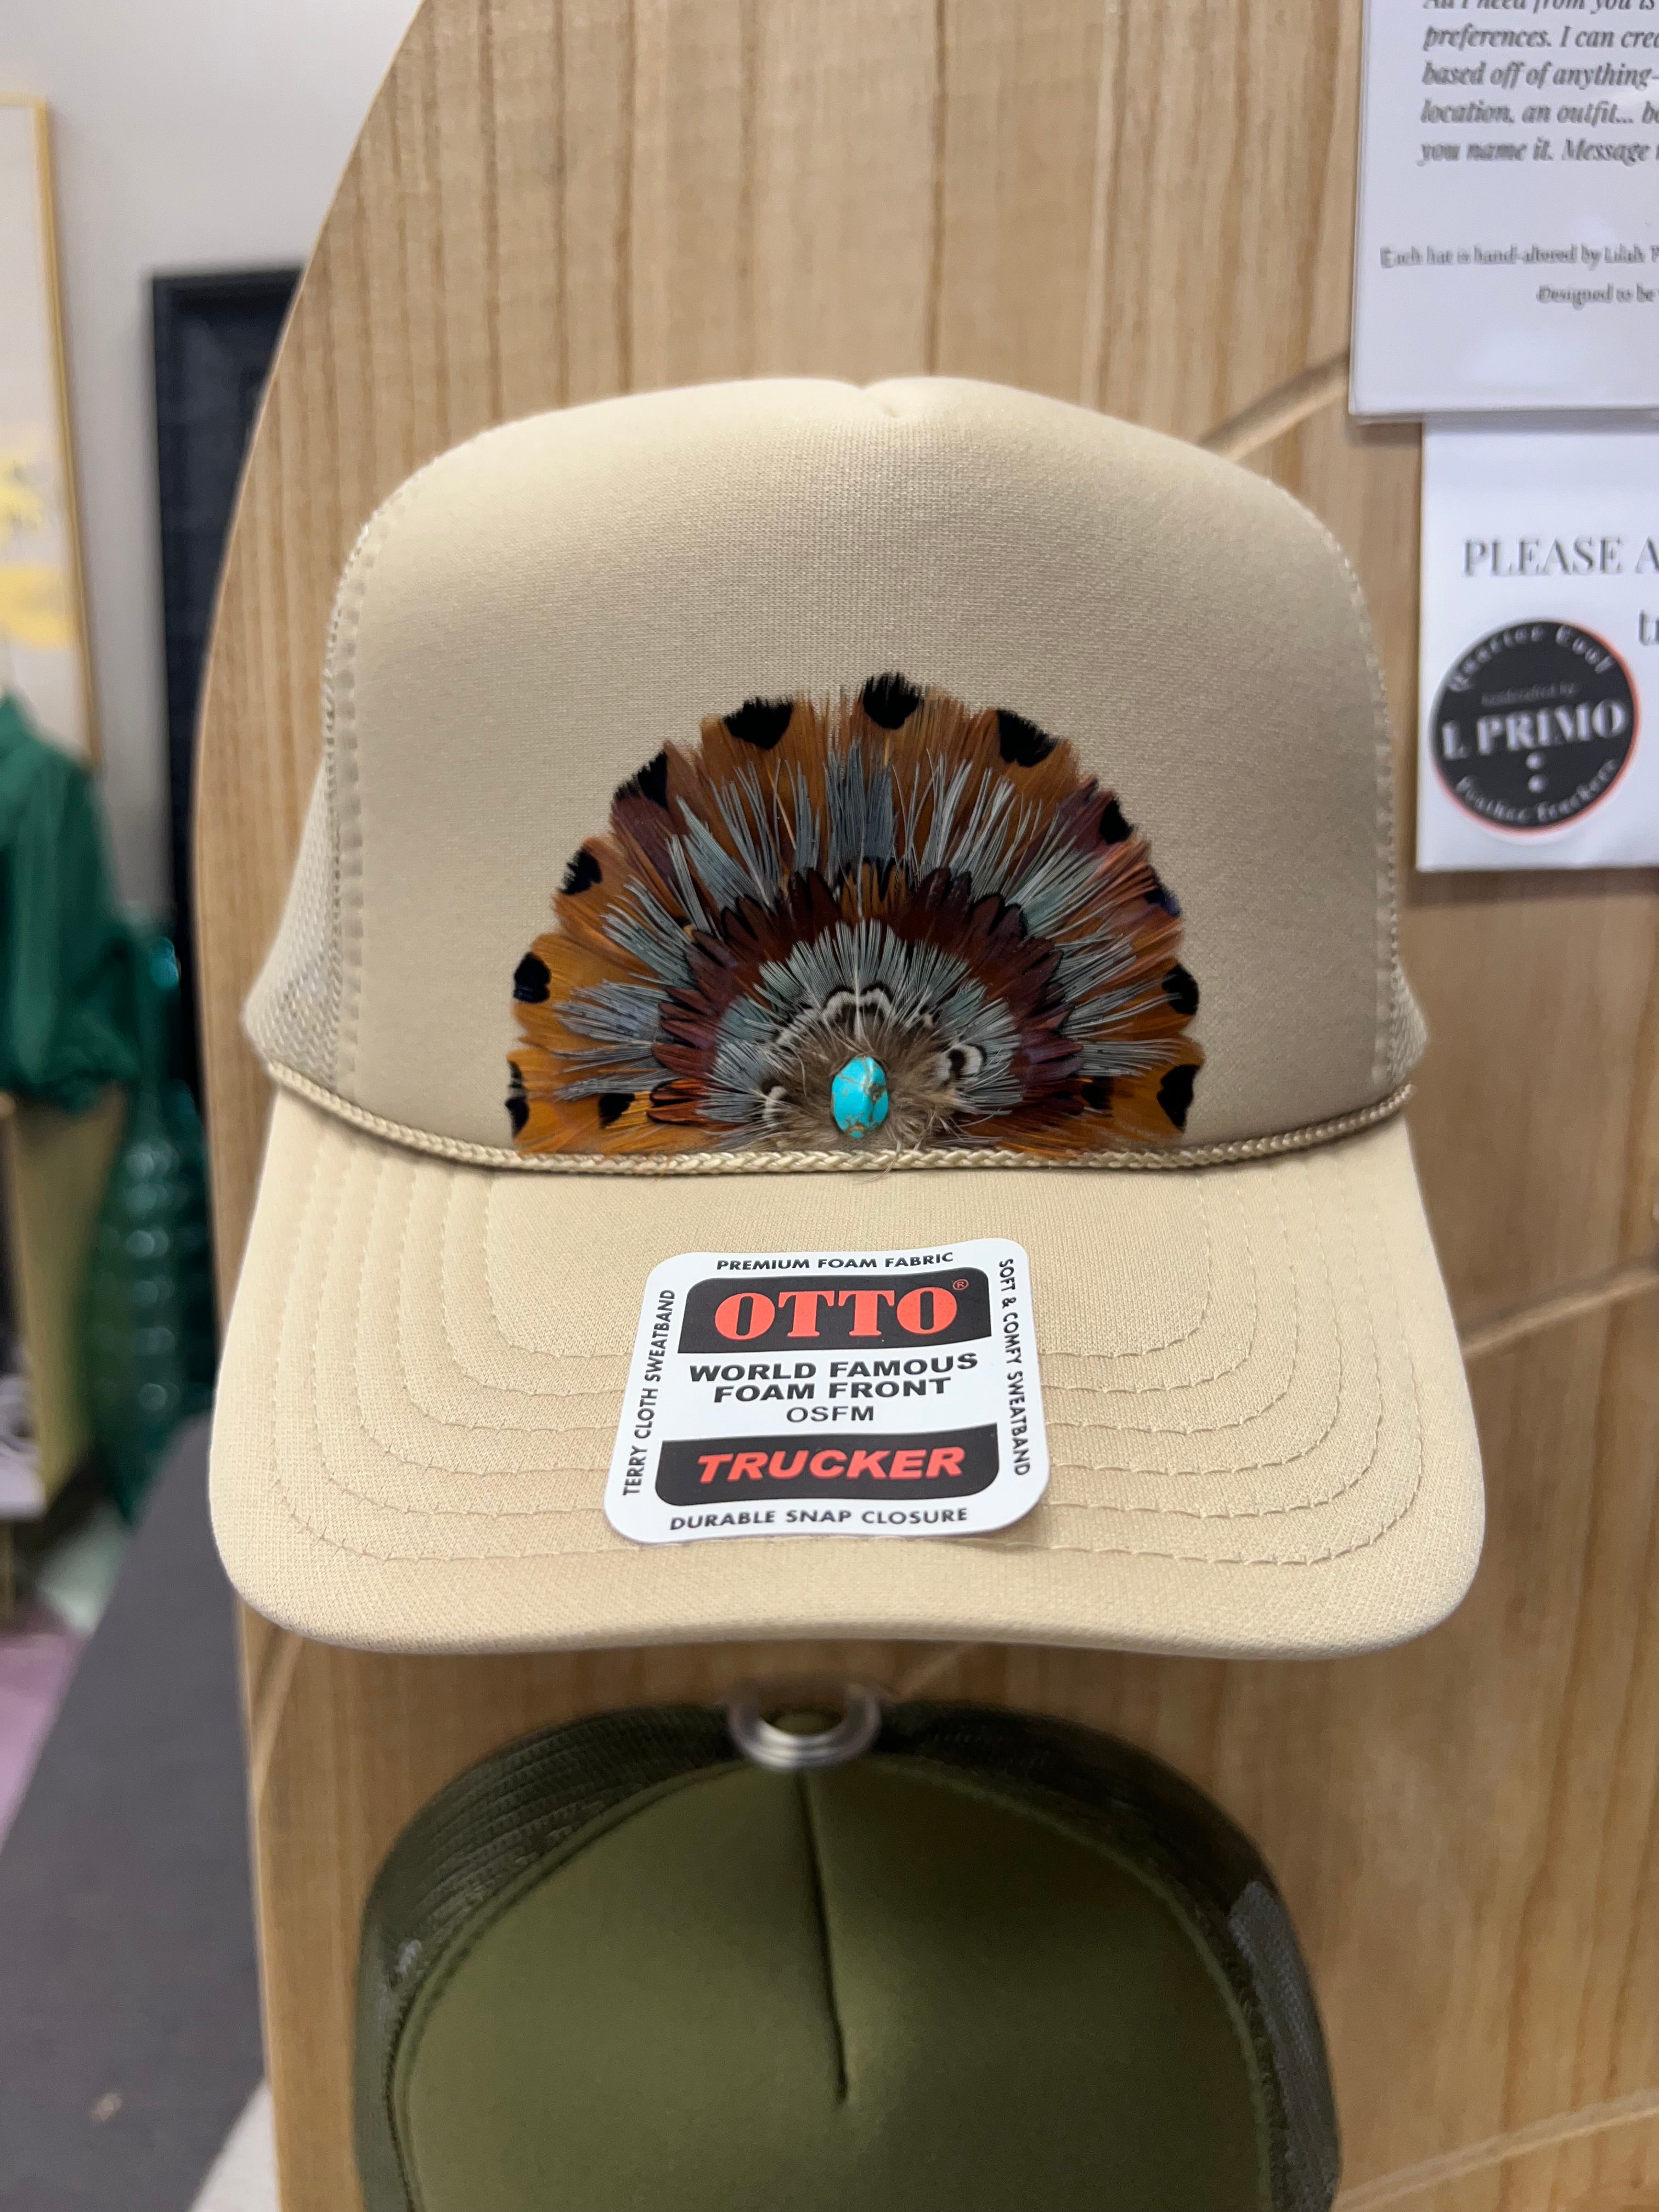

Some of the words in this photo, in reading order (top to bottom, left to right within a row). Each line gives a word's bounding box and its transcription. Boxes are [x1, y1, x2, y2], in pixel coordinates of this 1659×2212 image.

[1423, 22, 1551, 52] preferences.
[1560, 25, 1572, 48] I
[1575, 31, 1615, 48] can
[1422, 60, 1486, 85] based
[1490, 60, 1526, 90] off
[1525, 61, 1553, 91] of
[1420, 98, 1515, 124] location,
[1522, 105, 1551, 124] an
[1417, 144, 1461, 165] you
[1466, 143, 1527, 161] name
[1532, 136, 1554, 161] it.
[1561, 138, 1650, 166] Message
[1581, 242, 1602, 271] by
[1537, 283, 1614, 311] Designed
[1463, 535, 1624, 577] PLEASE
[1476, 697, 1628, 757] PRIMO
[716, 1258, 810, 1271] PREMIUM
[818, 1257, 877, 1269] FOAM
[885, 1251, 953, 1268] FABRIC
[998, 1258, 1016, 1292] SOFT
[1002, 1296, 1017, 1310] &
[644, 1289, 675, 1383] SWEATBAND
[1002, 1312, 1023, 1364] COMFY
[689, 1361, 817, 1382] WORLD
[829, 1352, 978, 1378] FAMOUS
[714, 1383, 815, 1403] FOAM
[828, 1376, 952, 1398] FRONT
[634, 1387, 659, 1440] CLOTH
[786, 1405, 874, 1423] OSFM
[1007, 1370, 1031, 1476] SWEATBAND
[622, 1444, 648, 1496] TERRY
[697, 1446, 966, 1483] TRUCKER
[670, 1510, 776, 1531] DURABLE
[786, 1509, 852, 1523] SNAP
[861, 1508, 968, 1525] CLOSURE
